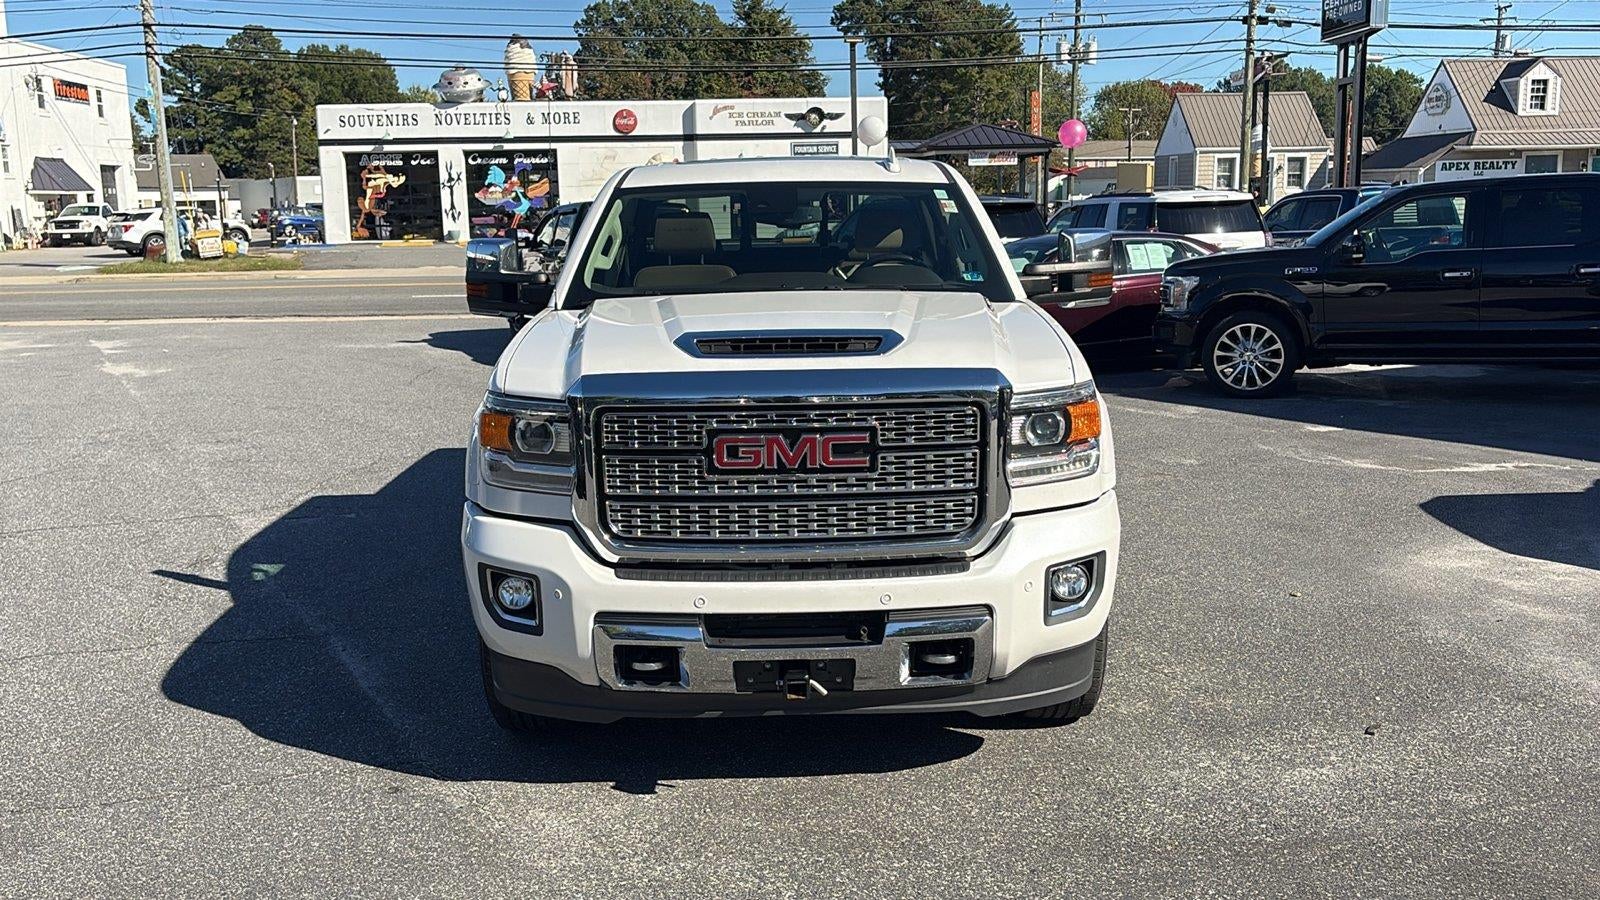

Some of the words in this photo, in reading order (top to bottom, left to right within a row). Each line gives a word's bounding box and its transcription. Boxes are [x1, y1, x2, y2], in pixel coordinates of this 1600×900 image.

[338, 113, 419, 128] SOUVENIRS
[434, 112, 511, 126] NOVELTIES
[526, 112, 535, 125] &
[541, 111, 581, 125] MORE
[728, 111, 744, 119] ICE
[746, 111, 781, 119] CREAM
[735, 119, 775, 127] PARLOR
[818, 145, 837, 153] SERVICE
[359, 153, 403, 166] ACME
[410, 153, 436, 166] Ice
[467, 153, 508, 165] Cream
[1440, 161, 1470, 171] APEX
[1473, 160, 1518, 171] REALTY
[713, 433, 870, 469] GMC
